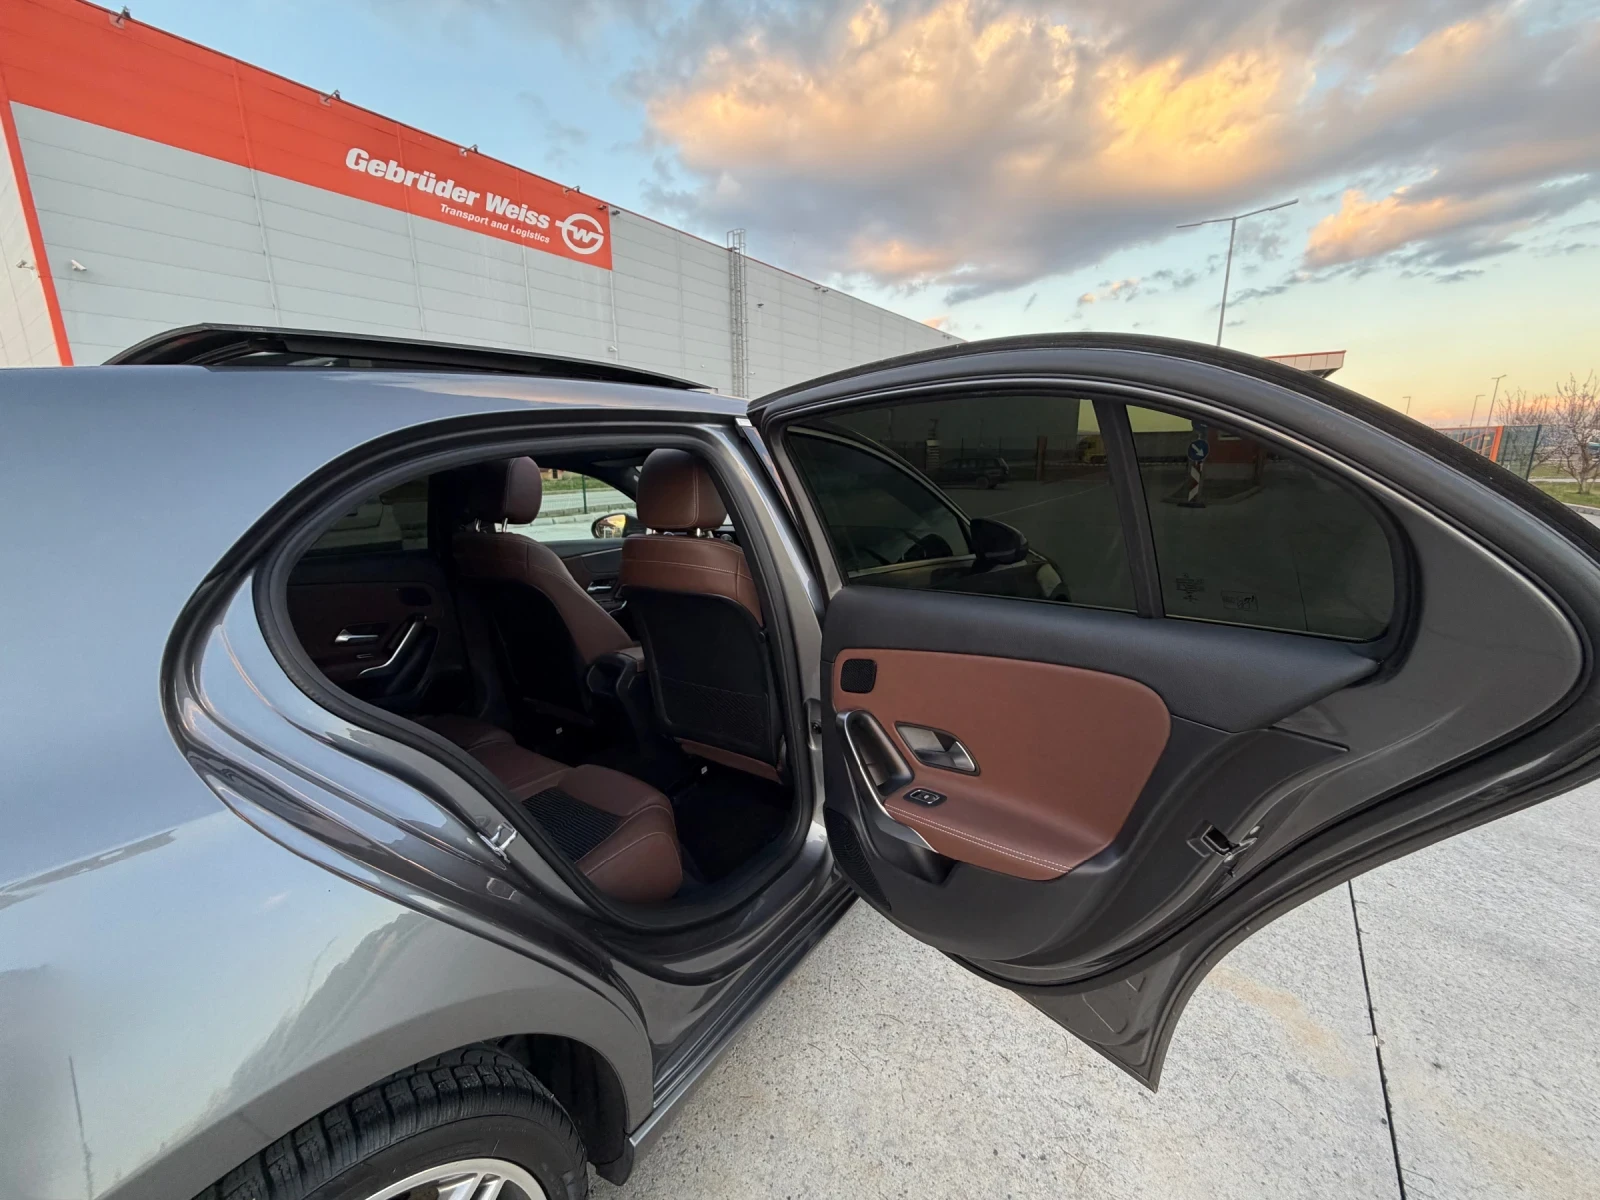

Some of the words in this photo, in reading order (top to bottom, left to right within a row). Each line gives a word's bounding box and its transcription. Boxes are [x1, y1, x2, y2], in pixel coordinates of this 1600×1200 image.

[345, 148, 480, 206] Gebrüder
[485, 192, 550, 229] Weiss
[440, 203, 489, 225] Transport
[490, 219, 509, 230] and
[510, 225, 550, 243] Logistics
